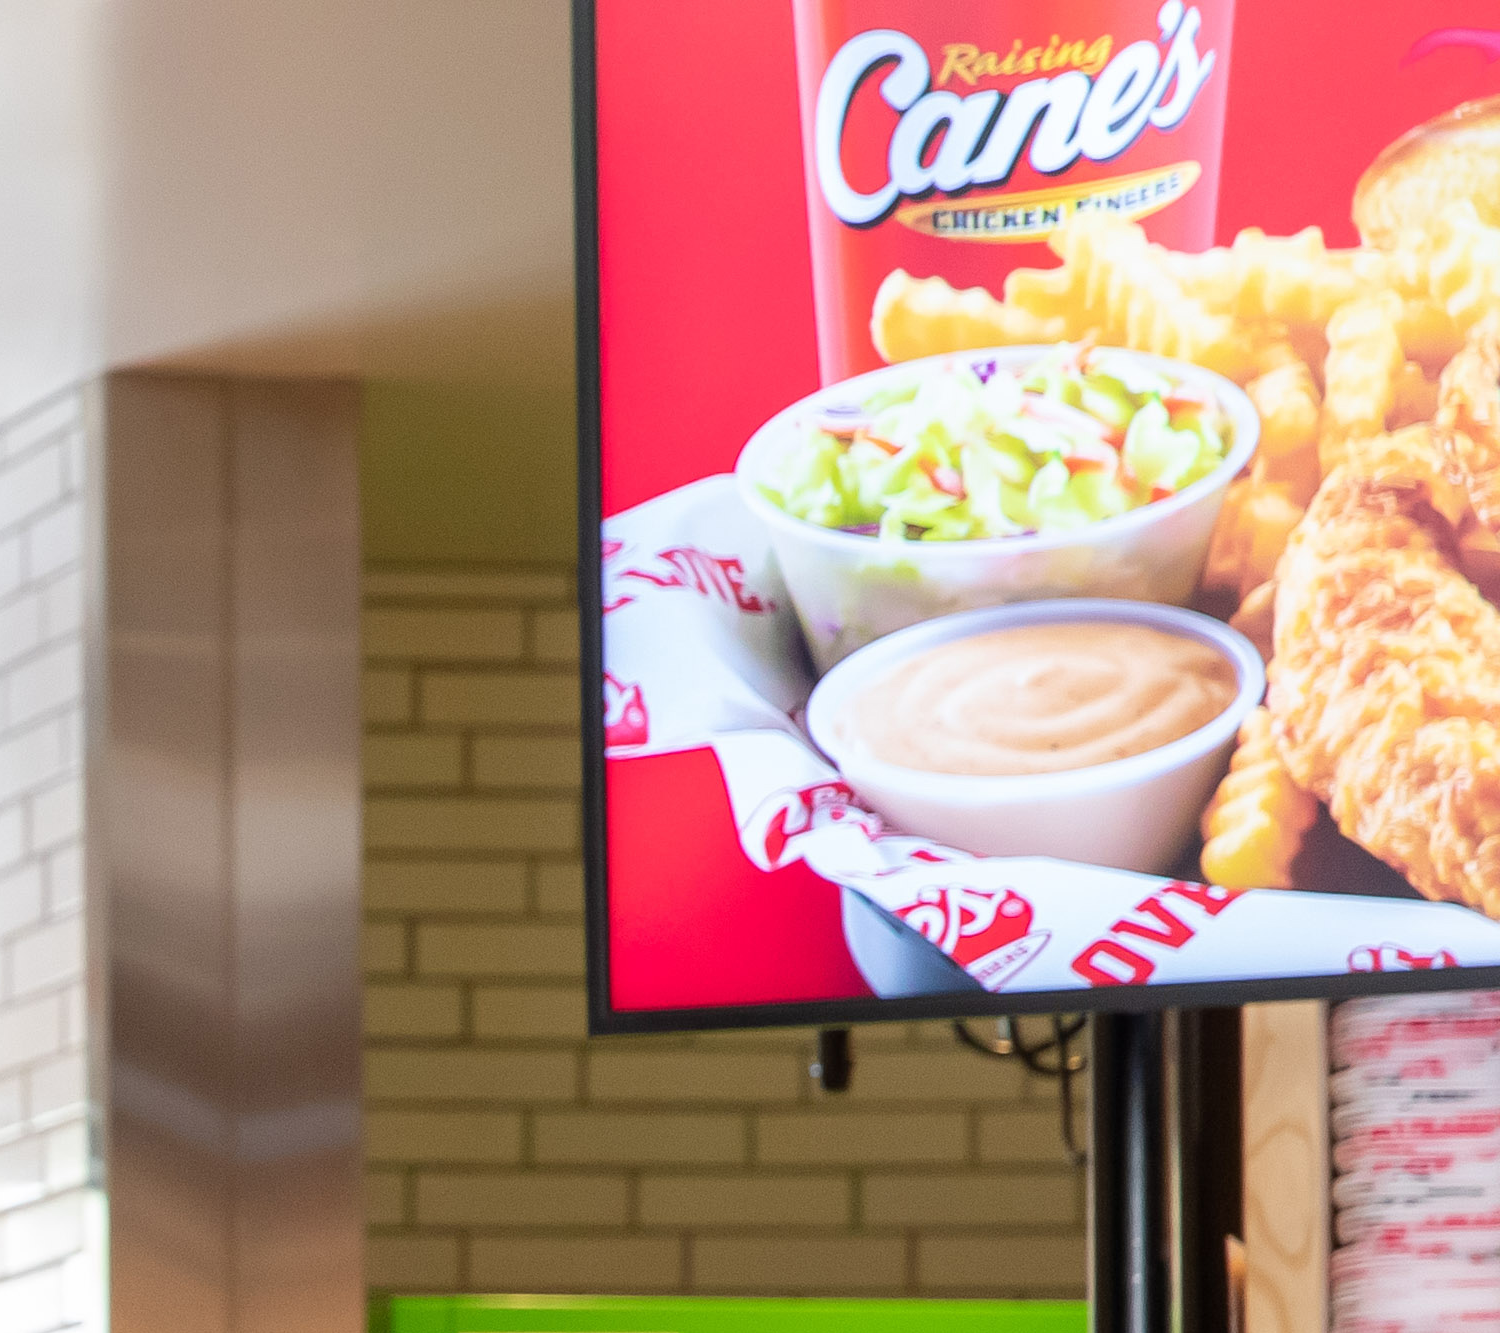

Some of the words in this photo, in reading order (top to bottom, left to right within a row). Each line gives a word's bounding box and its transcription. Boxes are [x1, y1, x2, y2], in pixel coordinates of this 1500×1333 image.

[937, 34, 1114, 86] Raising
[814, 0, 1217, 230] Cane's
[930, 205, 1061, 236] CHICKEN
